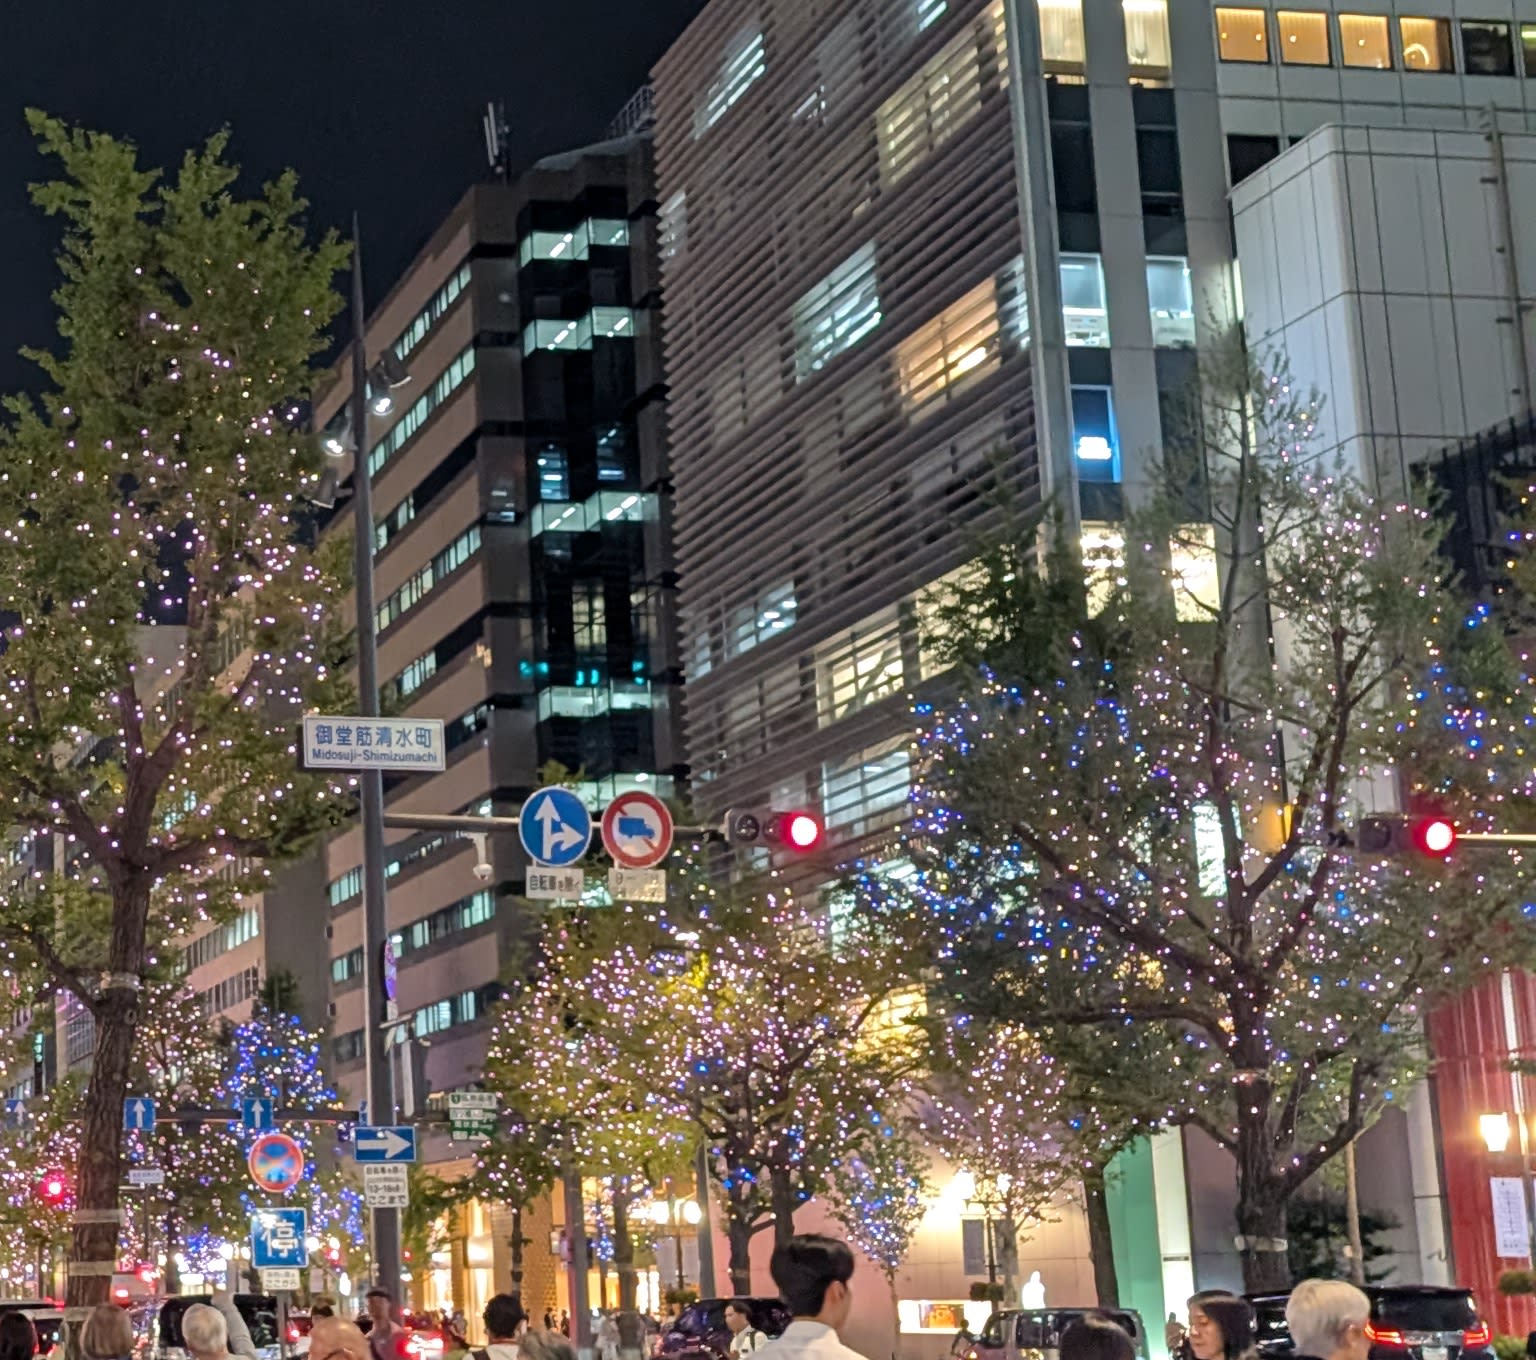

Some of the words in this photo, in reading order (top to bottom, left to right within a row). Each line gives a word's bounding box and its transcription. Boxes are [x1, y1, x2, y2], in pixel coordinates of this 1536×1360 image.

[315, 724, 433, 748] 御堂筋清水町
[312, 748, 437, 763] Midosuji-Shimizumachi
